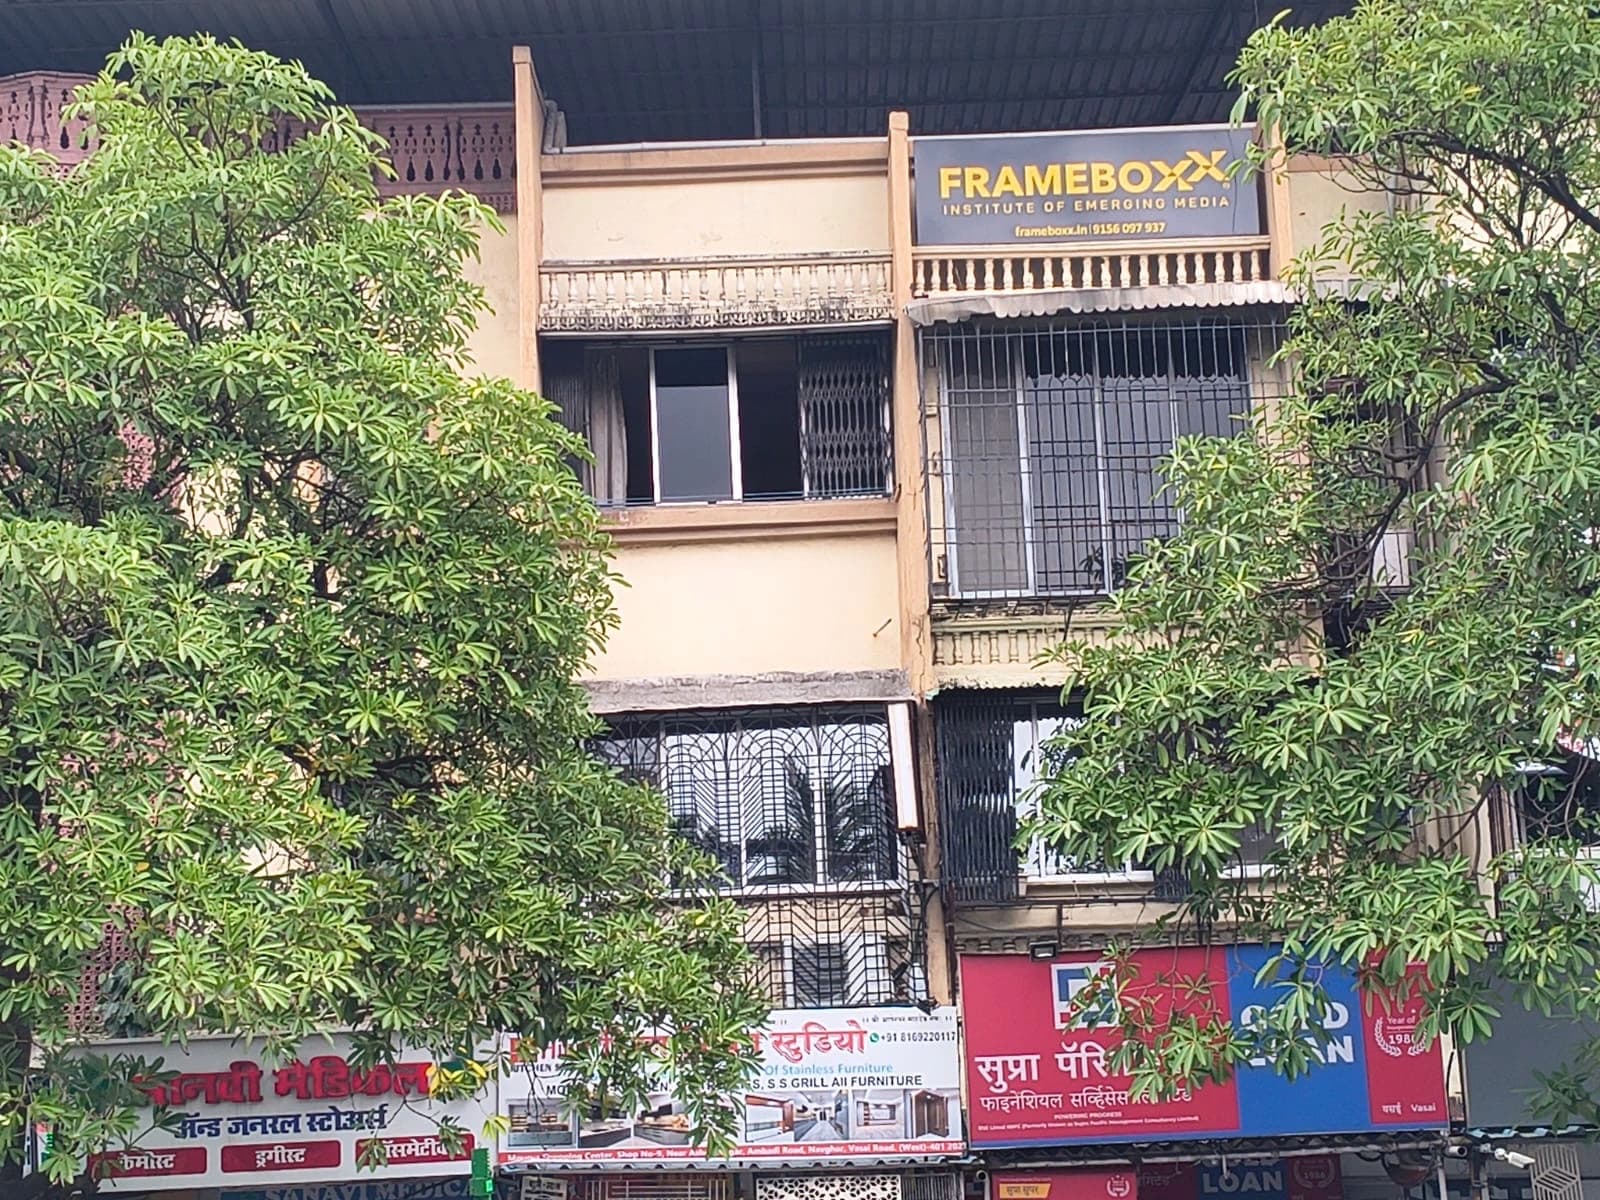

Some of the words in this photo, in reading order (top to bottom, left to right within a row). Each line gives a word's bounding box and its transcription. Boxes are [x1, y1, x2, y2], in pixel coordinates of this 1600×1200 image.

[939, 150, 1228, 199] FRAMEBOXX
[943, 201, 1036, 216] INSTITUTE
[1044, 200, 1065, 213] OF
[1074, 198, 1166, 212] EMERGING
[1174, 196, 1230, 209] MEDIA
[1092, 223, 1121, 235] 9156
[1122, 222, 1142, 234] 097
[1145, 222, 1165, 233] 937
[769, 1019, 868, 1063] स्टुडियो
[881, 1032, 897, 1042] +91
[782, 1063, 835, 1075] Stainless
[838, 1063, 893, 1075] Furniture
[974, 1054, 1041, 1093] सुप्रा
[791, 1077, 829, 1088] GRILL
[851, 1075, 923, 1087] FURNITURE
[1410, 1102, 1437, 1112] Vasai
[227, 1114, 301, 1137] जनरल
[1203, 1170, 1283, 1193] LOAN
